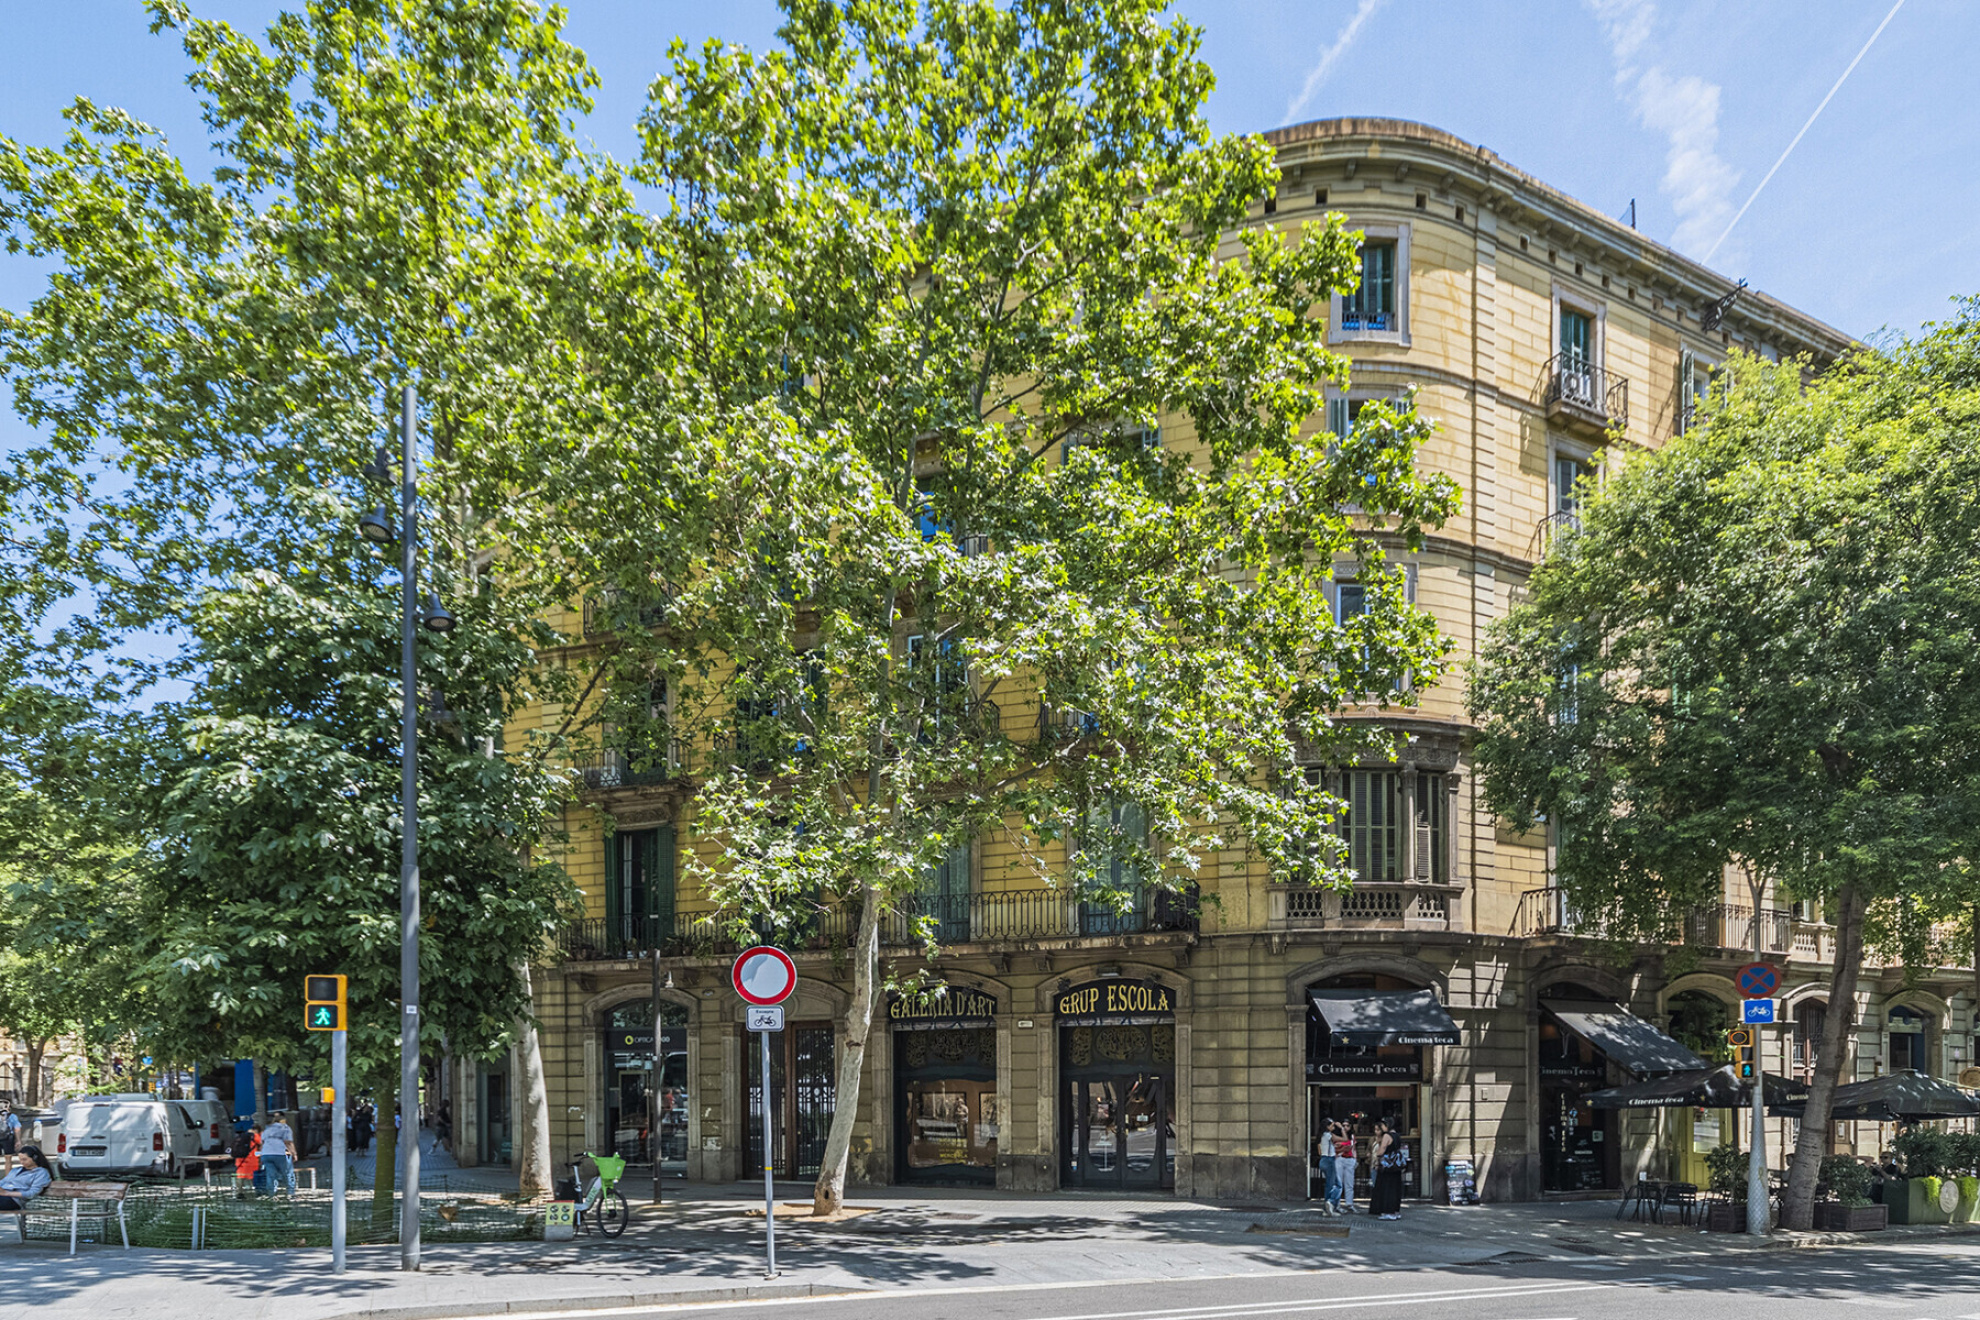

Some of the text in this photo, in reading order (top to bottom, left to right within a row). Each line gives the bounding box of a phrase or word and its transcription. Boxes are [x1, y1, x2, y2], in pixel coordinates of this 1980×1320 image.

[956, 991, 995, 1018] D'ART
[1059, 984, 1169, 1015] GRUP ESCOLÀ
[1318, 1063, 1407, 1075] CinemaTeca
[1540, 1066, 1596, 1076] inemaTeca
